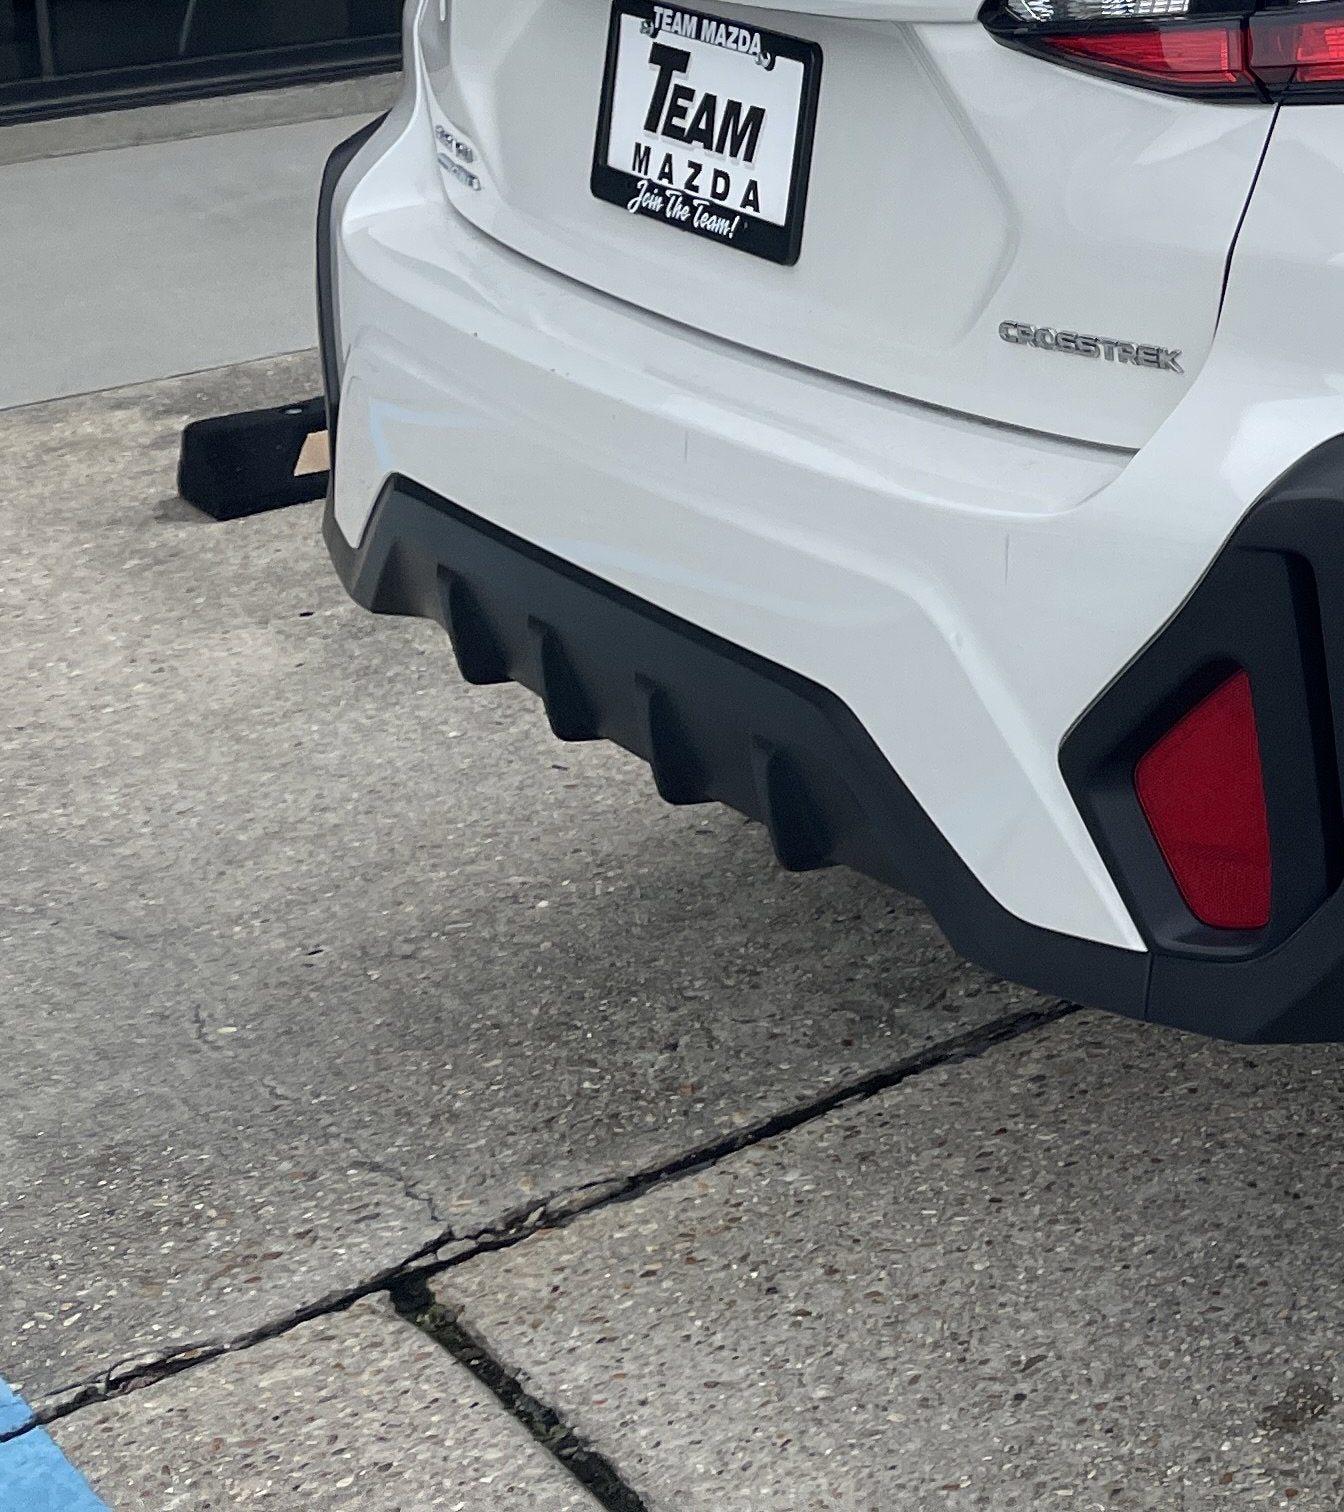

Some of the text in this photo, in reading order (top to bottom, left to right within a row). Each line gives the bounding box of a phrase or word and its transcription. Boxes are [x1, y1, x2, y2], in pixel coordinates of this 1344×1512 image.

[653, 5, 761, 56] TEAM MAZDA
[643, 42, 766, 163] TEAM
[631, 142, 761, 213] MAZDA
[627, 179, 740, 239] Join The Team!
[998, 319, 1185, 375] CROSSTREK
